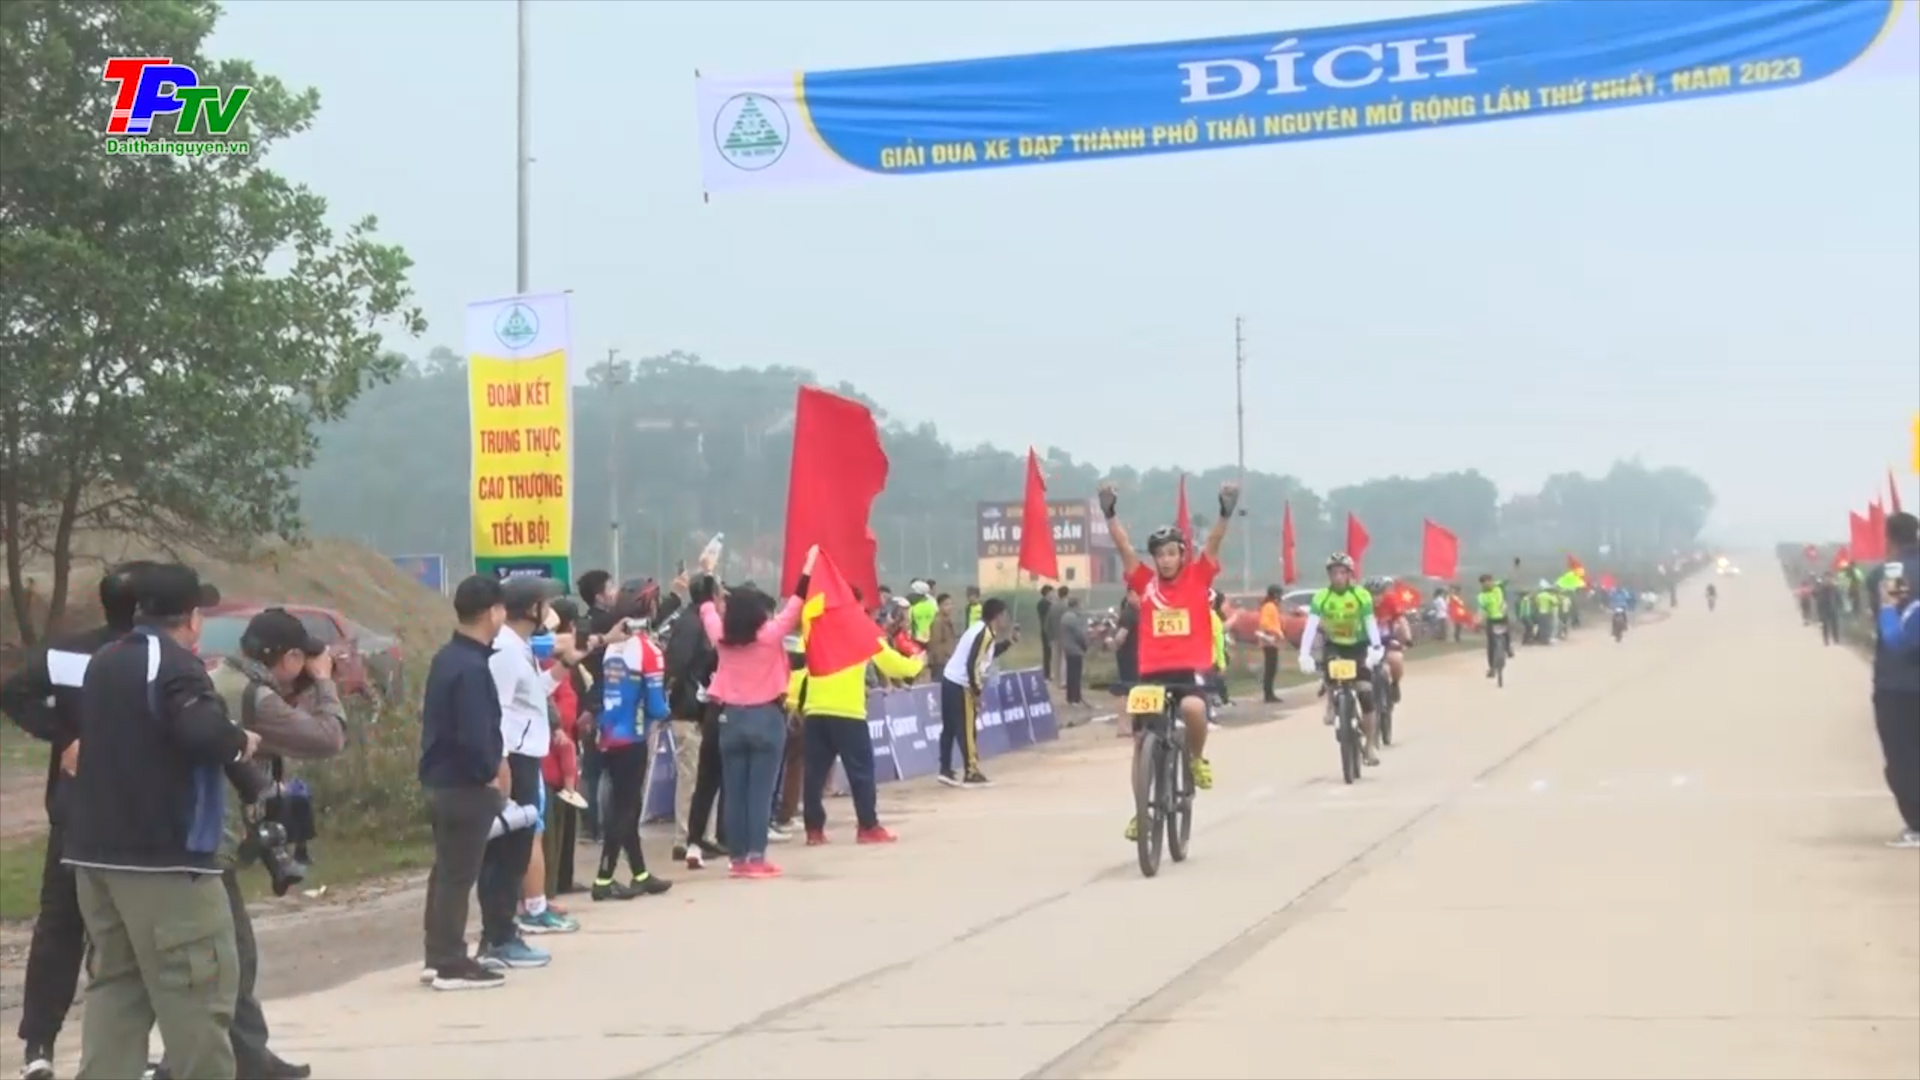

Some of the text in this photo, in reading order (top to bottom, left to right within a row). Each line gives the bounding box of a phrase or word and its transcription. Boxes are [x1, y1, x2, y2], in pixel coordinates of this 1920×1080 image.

[1178, 33, 1478, 103] ĐÍCH
[880, 137, 925, 169] GIẢI
[931, 141, 977, 164] ĐUA
[984, 137, 1012, 161] XE
[1018, 133, 1063, 162] ĐẠP
[1071, 126, 1146, 153] THÀNH
[1152, 115, 1199, 146] PHỐ
[1205, 113, 1257, 141] THÁI
[1263, 105, 1358, 136] NGUYÊN
[1365, 95, 1404, 127] MỞ
[1410, 94, 1477, 124] RỘNG
[1538, 78, 1587, 107] THỨ
[1739, 56, 1801, 85] 2023
[526, 374, 551, 406] KẾT
[480, 426, 562, 457] TRUNG THỰC
[479, 473, 563, 504] CAO THƯỢNG
[492, 513, 550, 550] TIẾN BỘ!
[1157, 620, 1183, 633] 251
[1132, 697, 1158, 710] 251
